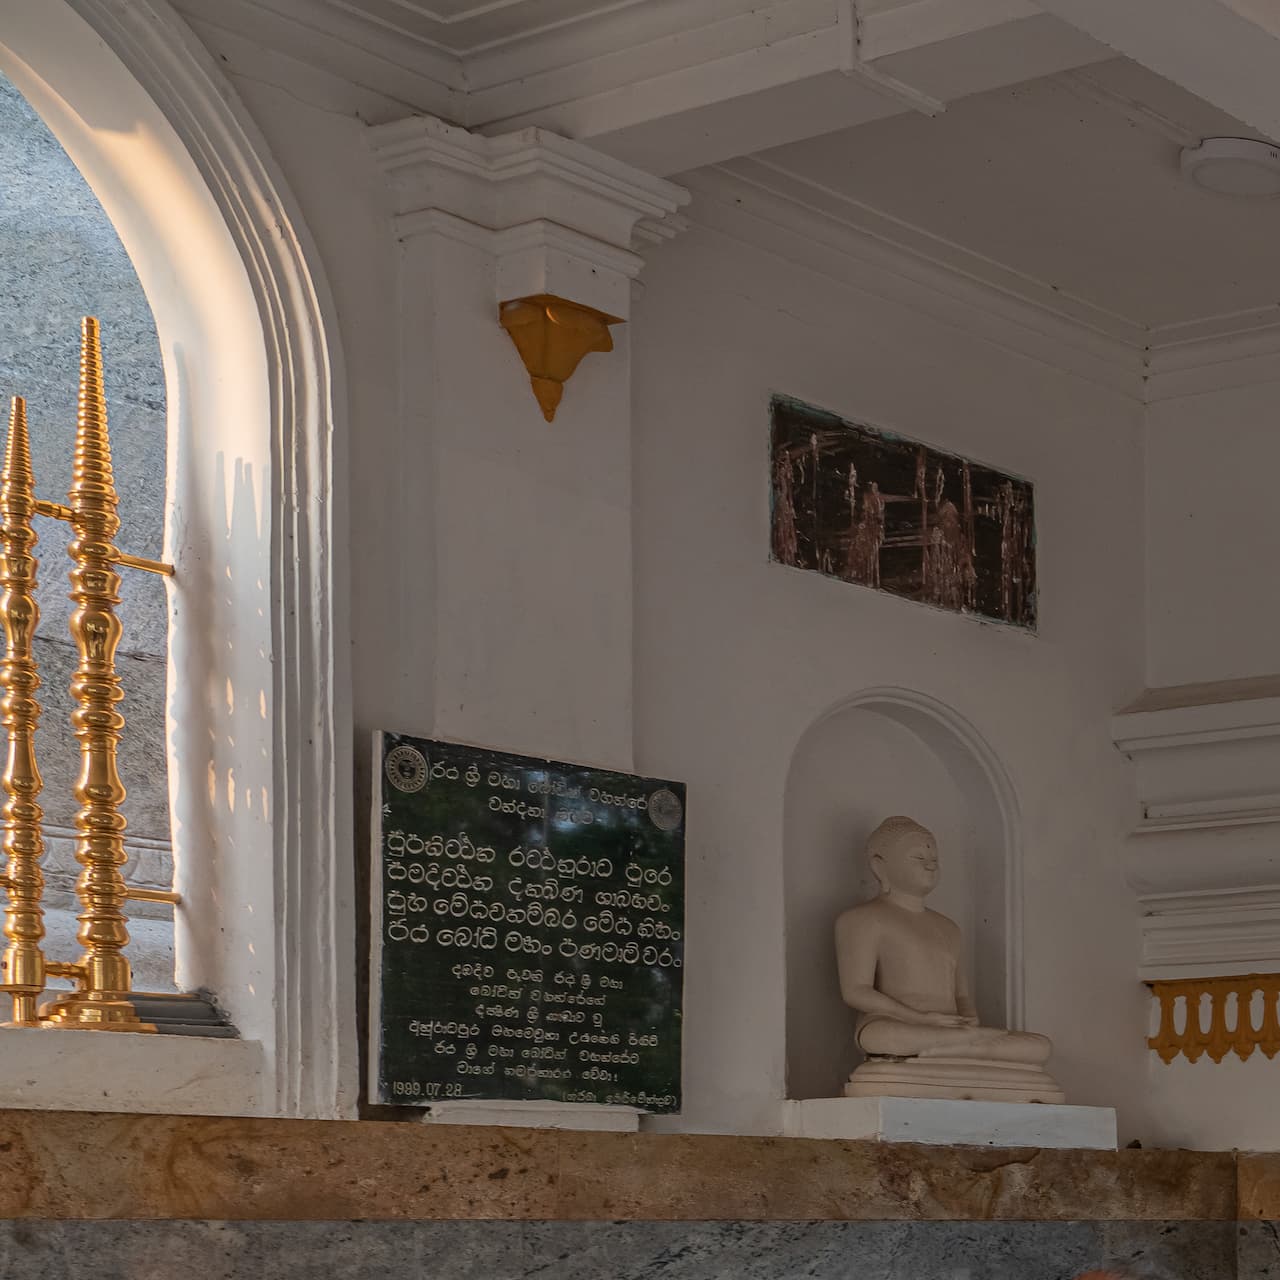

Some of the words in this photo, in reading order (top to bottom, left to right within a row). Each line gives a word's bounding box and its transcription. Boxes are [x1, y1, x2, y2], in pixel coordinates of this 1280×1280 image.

[431, 760, 459, 780] ජය
[488, 771, 520, 790] මහා
[590, 787, 648, 810] වහන්සේ
[488, 796, 544, 820] වන්දනා
[388, 918, 429, 943] ජය
[436, 926, 498, 949] බෝධි
[599, 975, 624, 990] මහා
[434, 1040, 456, 1055] ජය
[488, 1045, 514, 1058] මහා
[456, 1061, 496, 1076] මාගේ
[393, 1081, 462, 1097] 1999.07.28
